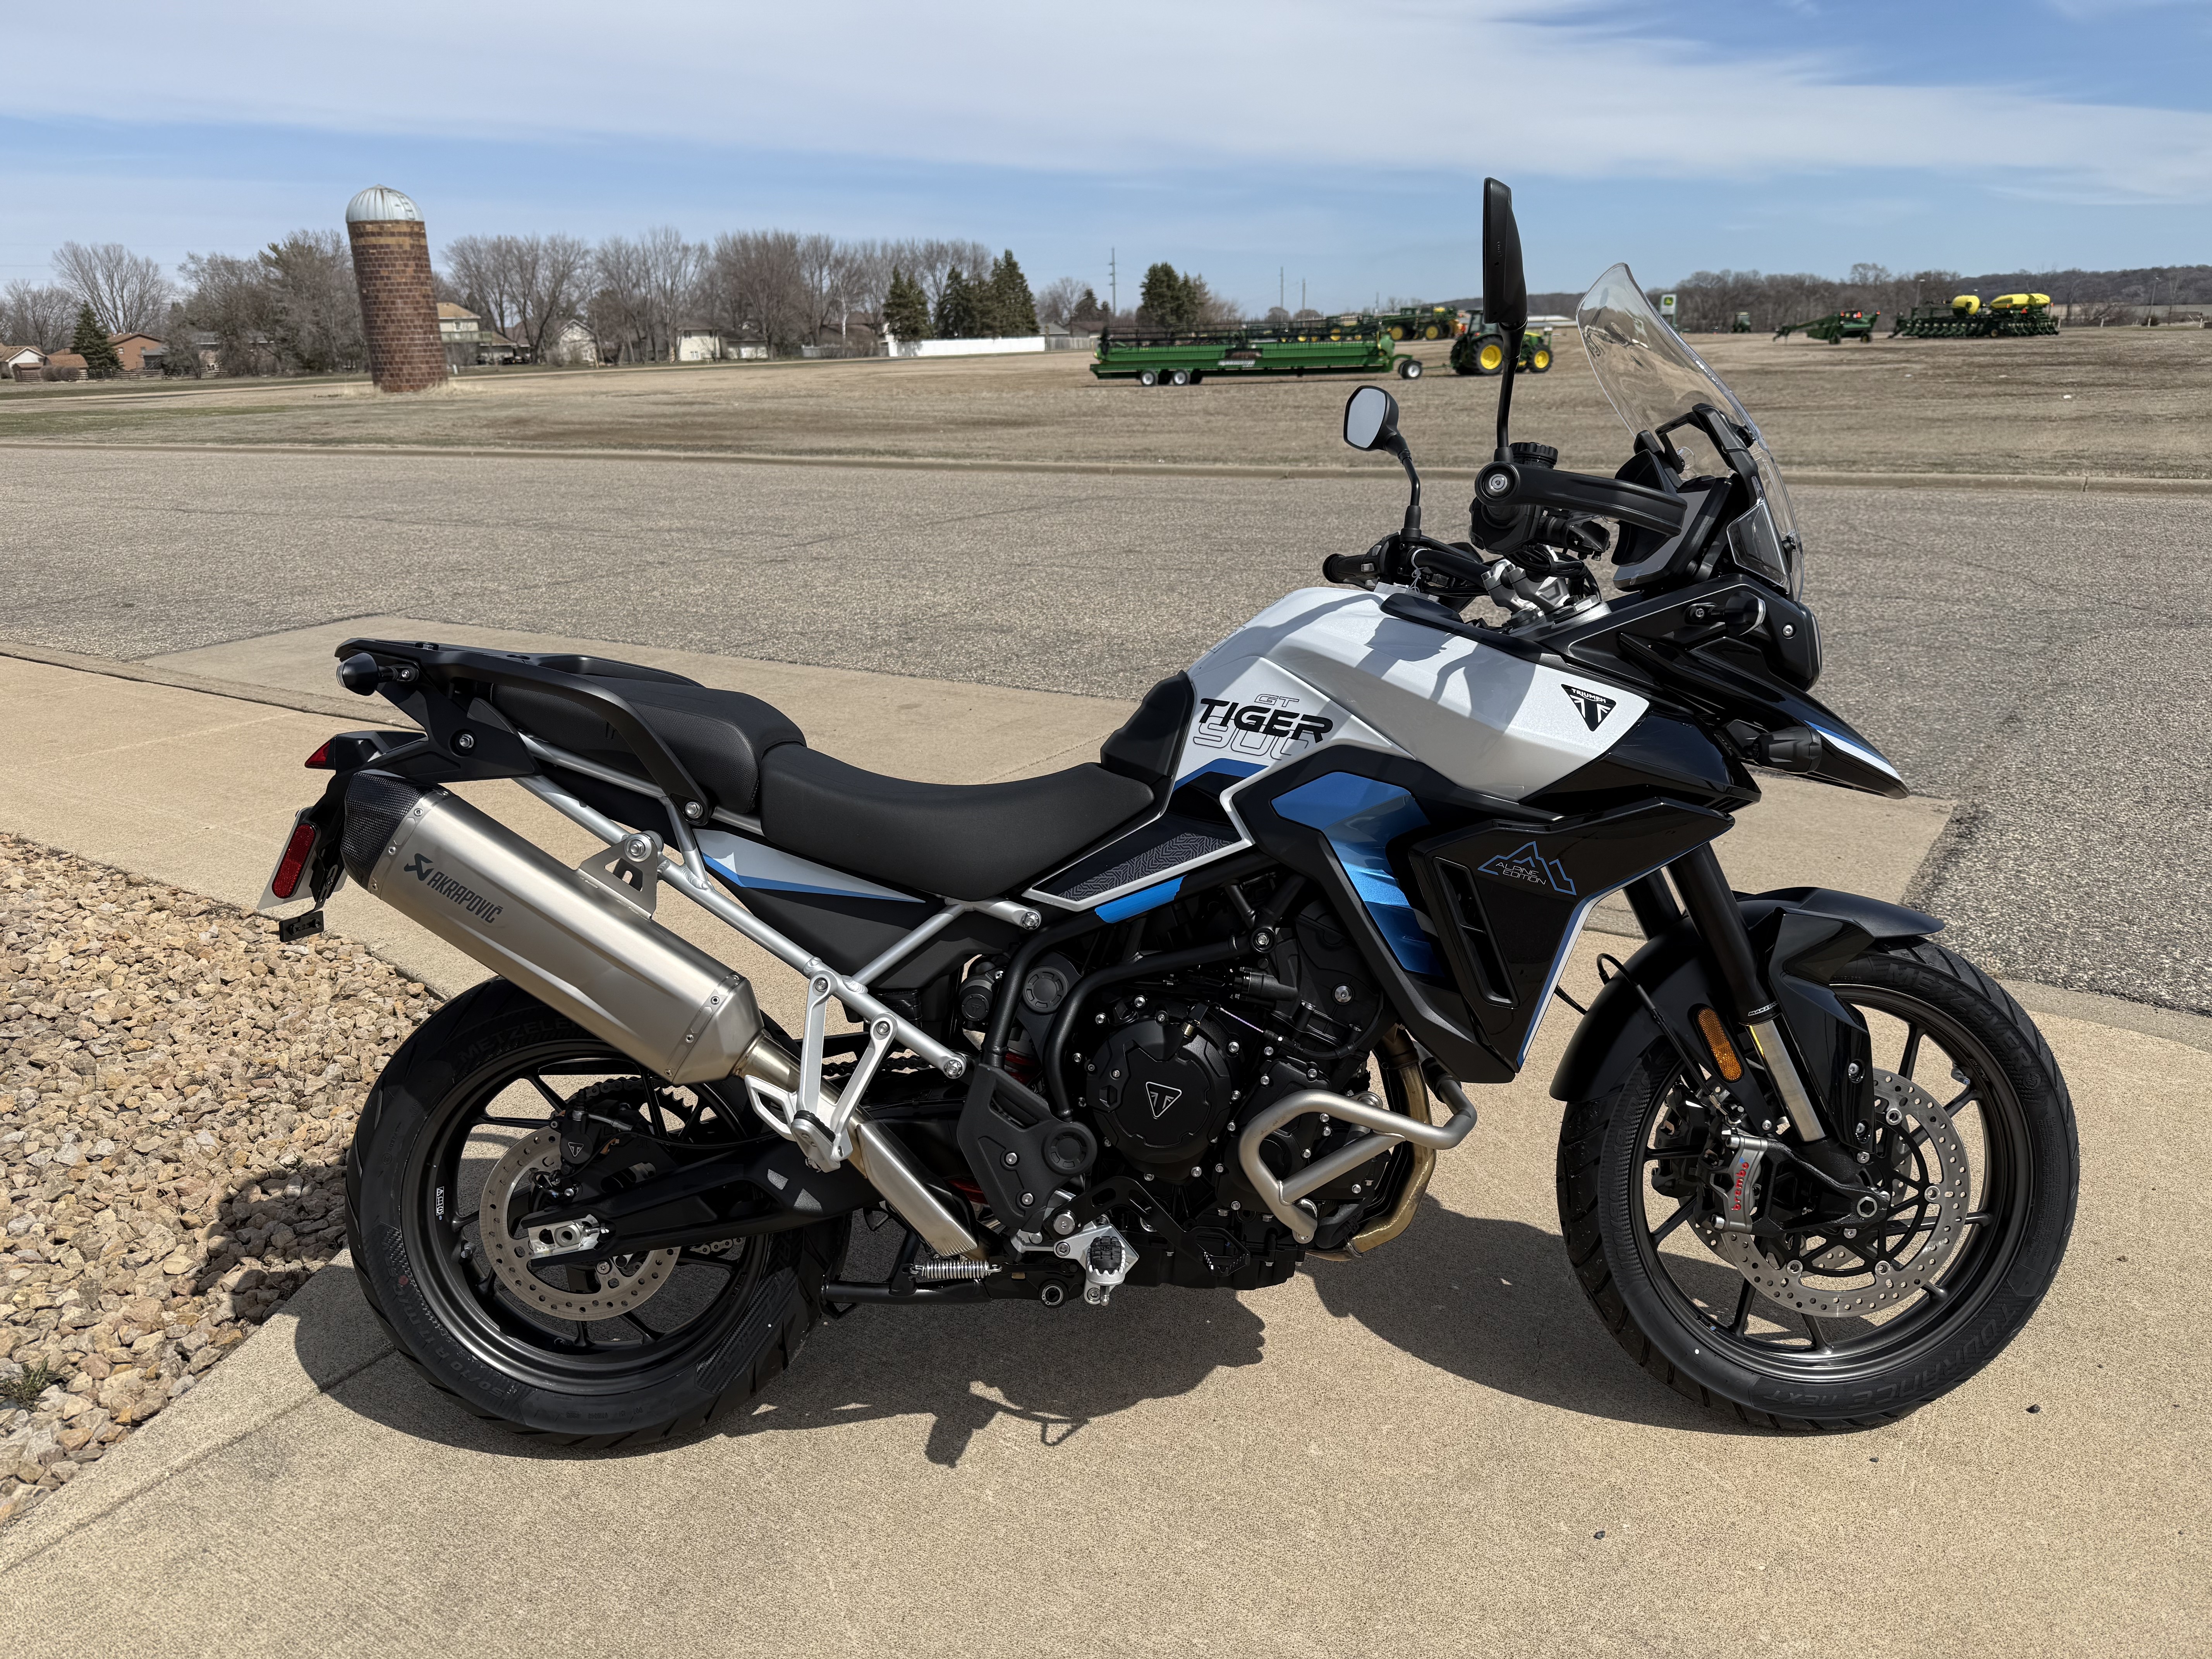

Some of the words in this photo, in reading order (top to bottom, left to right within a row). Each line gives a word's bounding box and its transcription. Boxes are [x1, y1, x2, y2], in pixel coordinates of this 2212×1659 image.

[1254, 694, 1300, 708] GT
[1571, 688, 1606, 704] TRIUMPH
[1199, 698, 1333, 744] TIGER
[1496, 862, 1539, 877] ALPINE
[1503, 869, 1546, 885] EDITION
[1885, 963, 2033, 1071] METZELER
[458, 1017, 580, 1064] METZELE
[1731, 1162, 1749, 1211] brembo
[418, 1328, 435, 1345] 17
[434, 1346, 450, 1360] R
[1847, 1305, 2016, 1411] TOURANCE
[1762, 1389, 1837, 1408] NEXT
